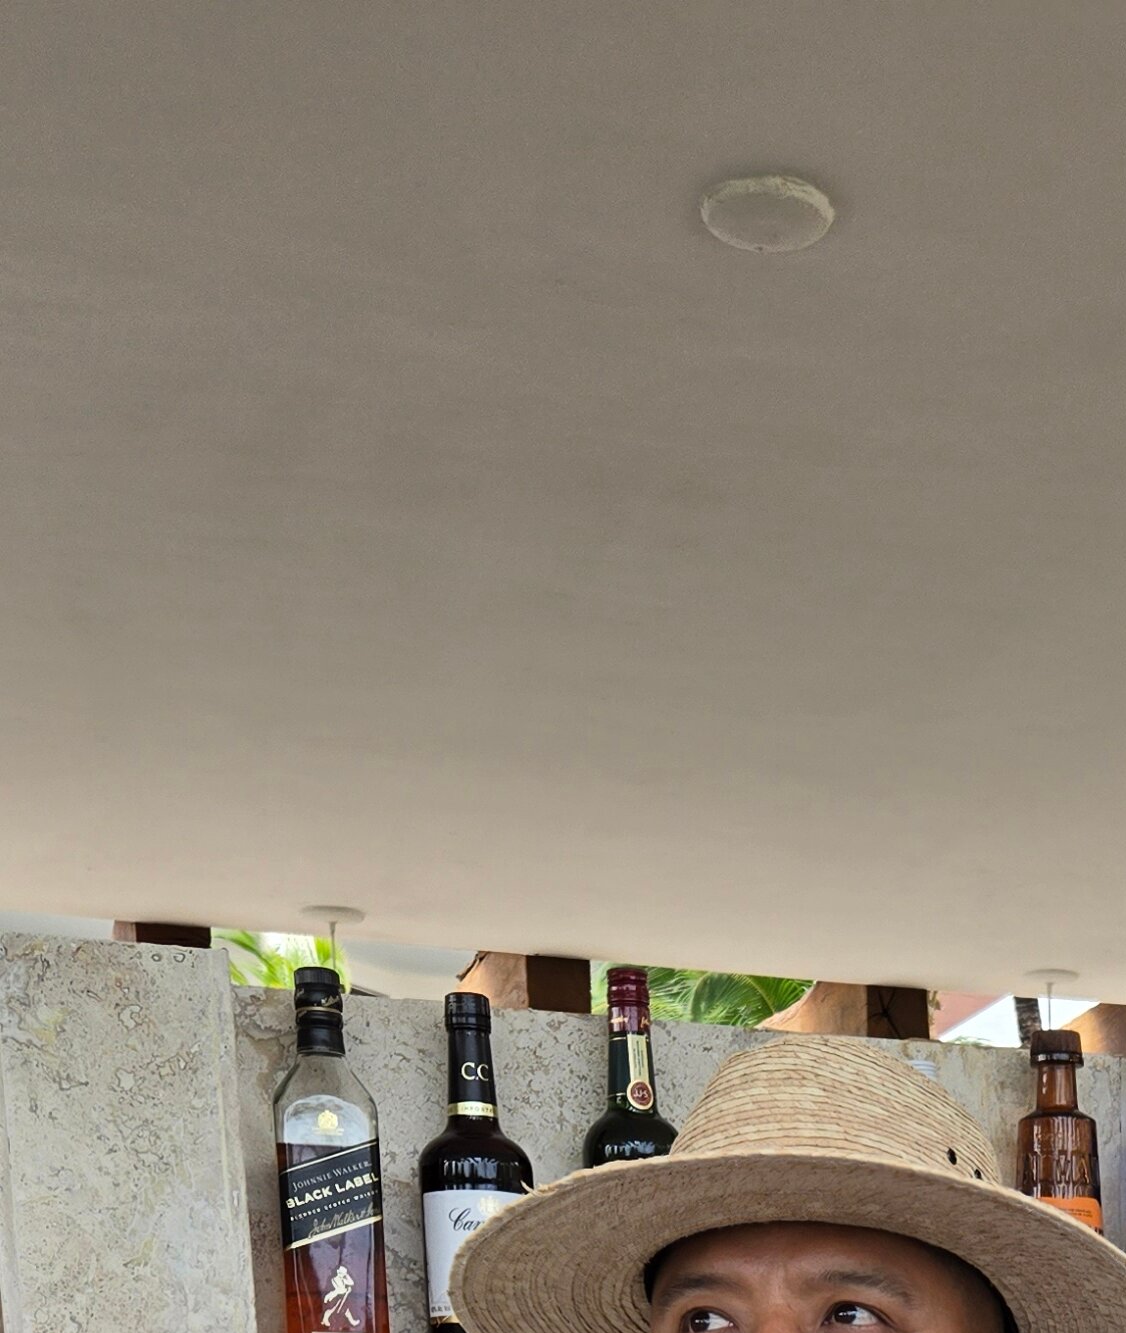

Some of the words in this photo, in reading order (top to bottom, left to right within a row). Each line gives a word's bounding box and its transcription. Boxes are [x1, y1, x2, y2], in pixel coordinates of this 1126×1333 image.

[286, 1186, 333, 1209] BLACK
[335, 1172, 379, 1194] LABEL
[292, 1173, 332, 1193] JOHNNIE
